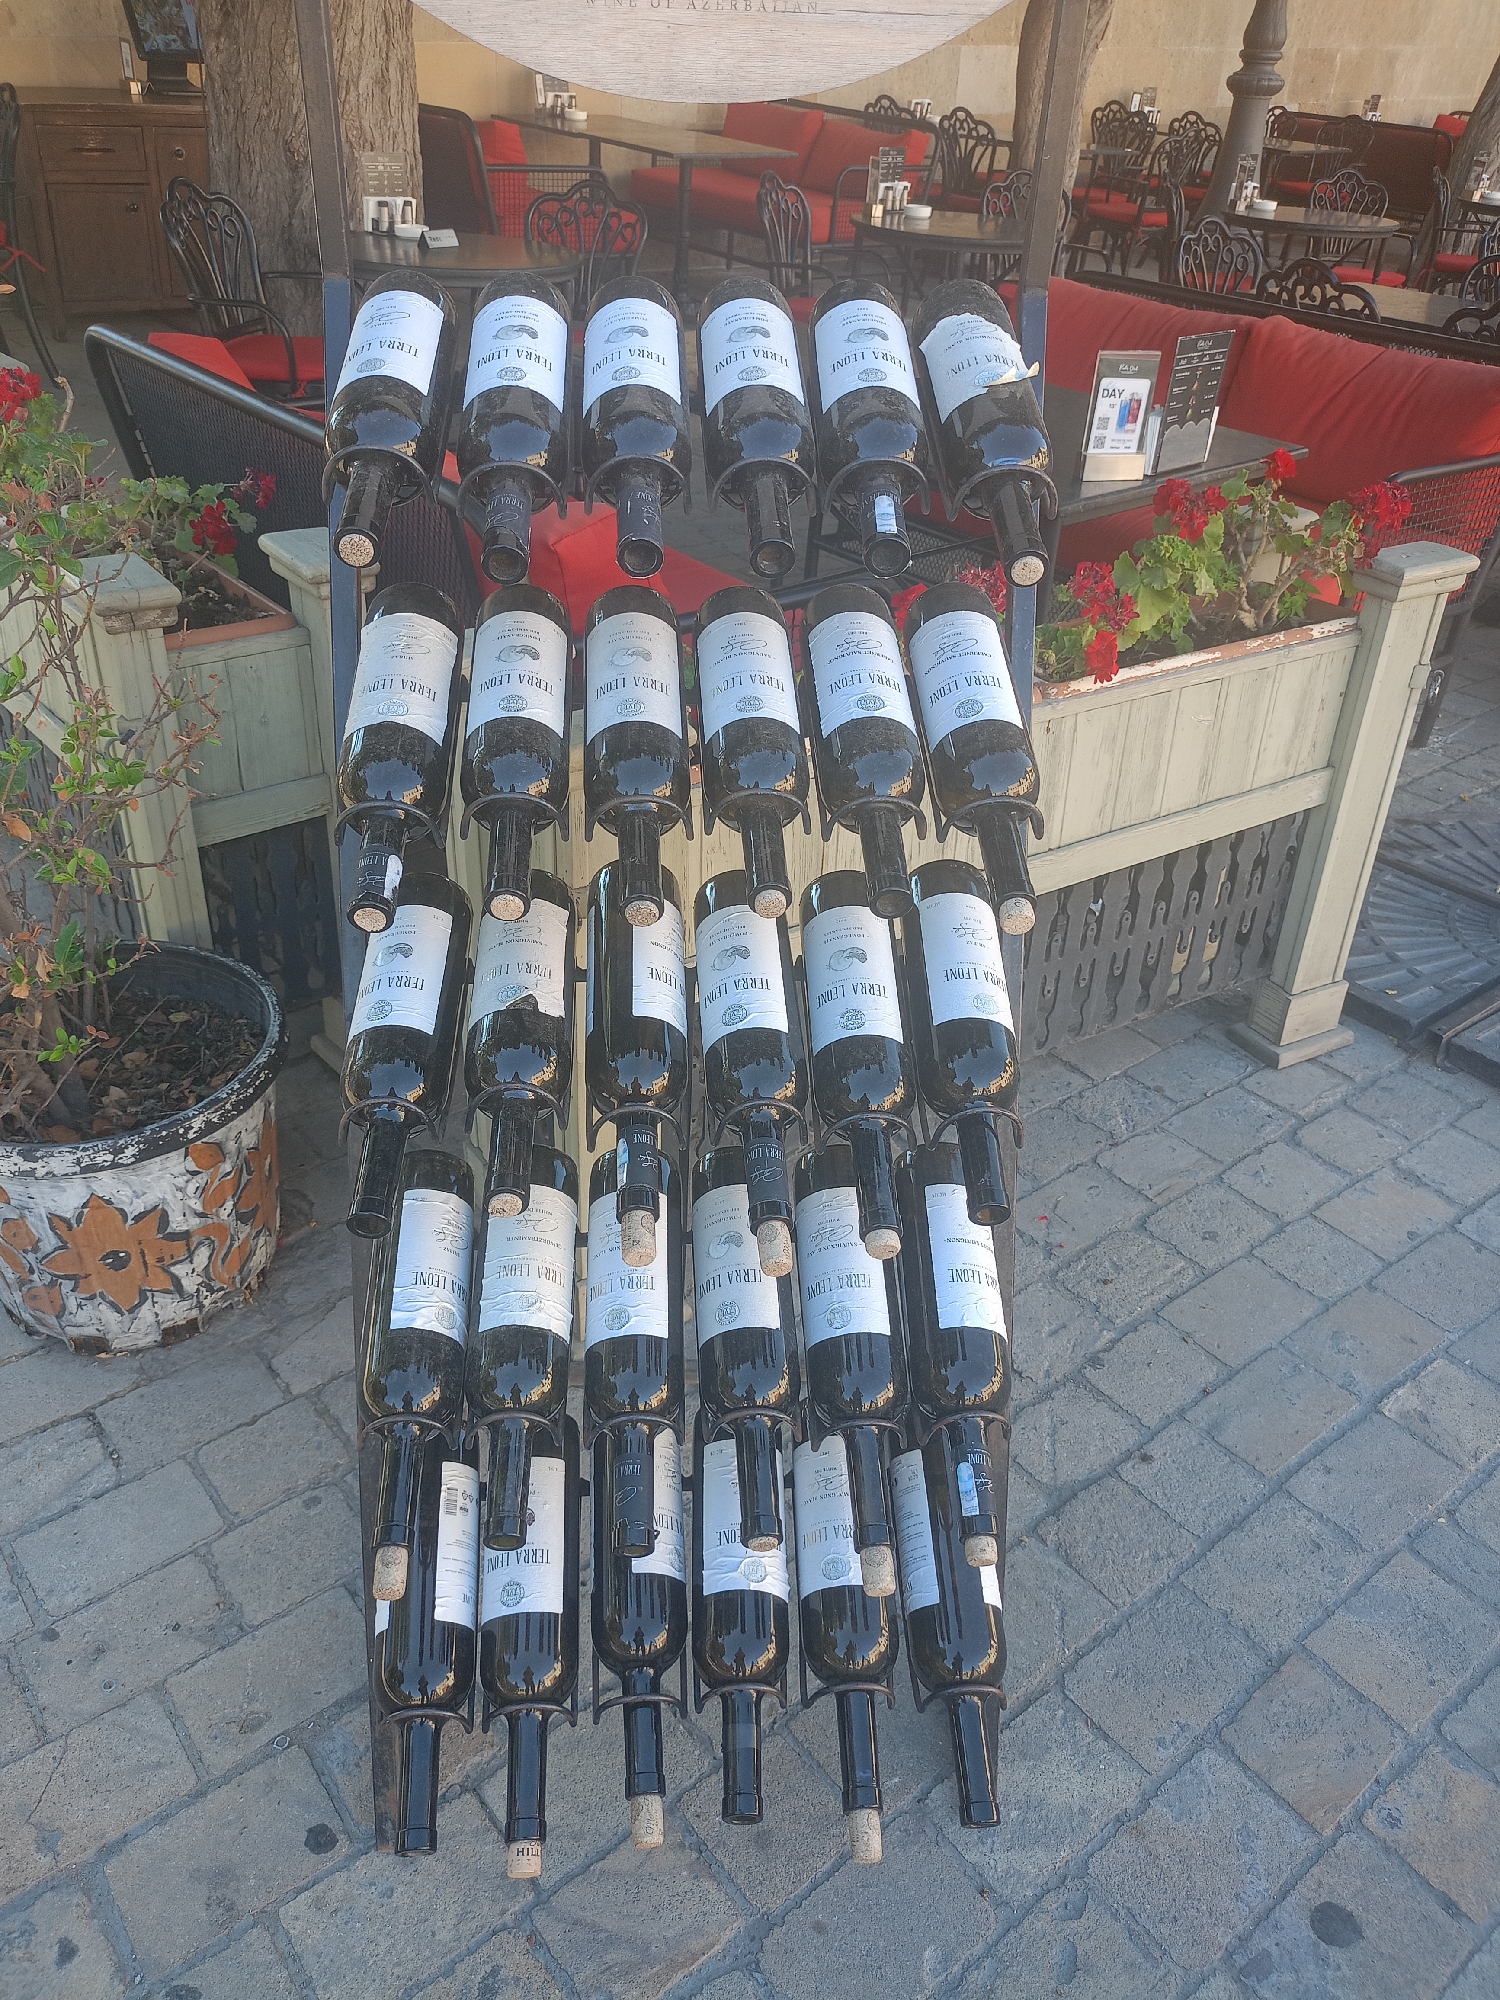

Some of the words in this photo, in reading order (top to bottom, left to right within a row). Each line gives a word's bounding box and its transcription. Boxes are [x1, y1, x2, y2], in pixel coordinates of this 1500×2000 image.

[650, 0, 672, 9] OF
[379, 339, 419, 359] TERRA
[475, 349, 508, 370] LEONE
[628, 348, 667, 366] TERRA
[752, 349, 790, 368] TERRA
[516, 349, 553, 371] TERRA
[591, 349, 621, 375] LEONE
[714, 350, 745, 376] LEONE
[830, 352, 865, 374] LEONE
[873, 351, 907, 373] TERRA
[1102, 388, 1125, 399] DAY
[732, 651, 773, 659] SAUVIGNON
[358, 677, 393, 699] LEONE
[402, 679, 436, 703] TERRA
[478, 674, 511, 697] LEONE
[518, 674, 554, 697] TERRA
[593, 678, 626, 702] LEONE
[634, 676, 669, 697] TERRA
[710, 675, 742, 700] LEONE
[749, 674, 786, 693] TERRA
[827, 673, 861, 696] LEONE
[868, 673, 902, 694] TERRA
[964, 675, 1003, 690] TERRA
[928, 680, 959, 709] LEONE
[387, 976, 424, 992] TERRA
[646, 967, 678, 990] LEONE
[733, 977, 771, 991] TERRA
[942, 967, 979, 983] LEONE
[704, 983, 727, 1011] LEONE
[814, 984, 845, 1010] LEONE
[850, 981, 888, 999] TERRA
[411, 1271, 447, 1290] LEONE
[495, 1264, 530, 1280] LEONE
[536, 1266, 566, 1288] TERRA
[727, 1269, 763, 1285] TERRA
[836, 1273, 872, 1288] TERRA
[947, 1268, 981, 1285] LEONE
[619, 1276, 656, 1291] TERRA
[697, 1274, 721, 1301] LEONE
[806, 1277, 830, 1302] LEONE
[716, 1529, 741, 1546] EONE
[801, 1527, 828, 1550] LEONE
[486, 1551, 509, 1575] LEONE
[514, 1549, 551, 1566] TERRA
